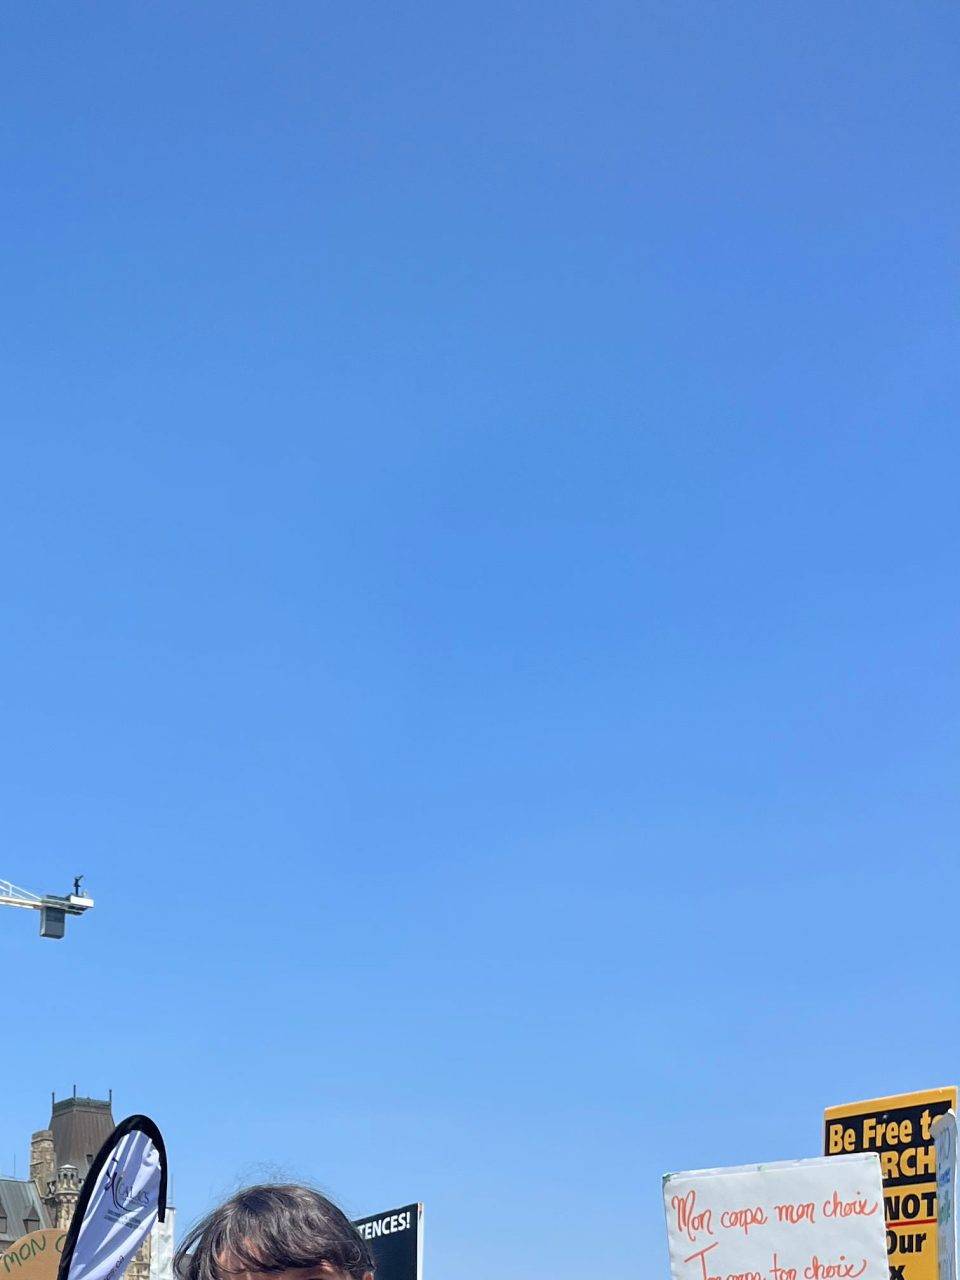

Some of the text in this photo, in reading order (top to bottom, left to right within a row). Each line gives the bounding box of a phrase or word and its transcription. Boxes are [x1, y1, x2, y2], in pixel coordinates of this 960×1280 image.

[828, 1124, 856, 1154] Be
[862, 1117, 913, 1149] Free
[671, 1190, 878, 1242] Mon corps mon choix
[803, 1255, 867, 1280] choix
